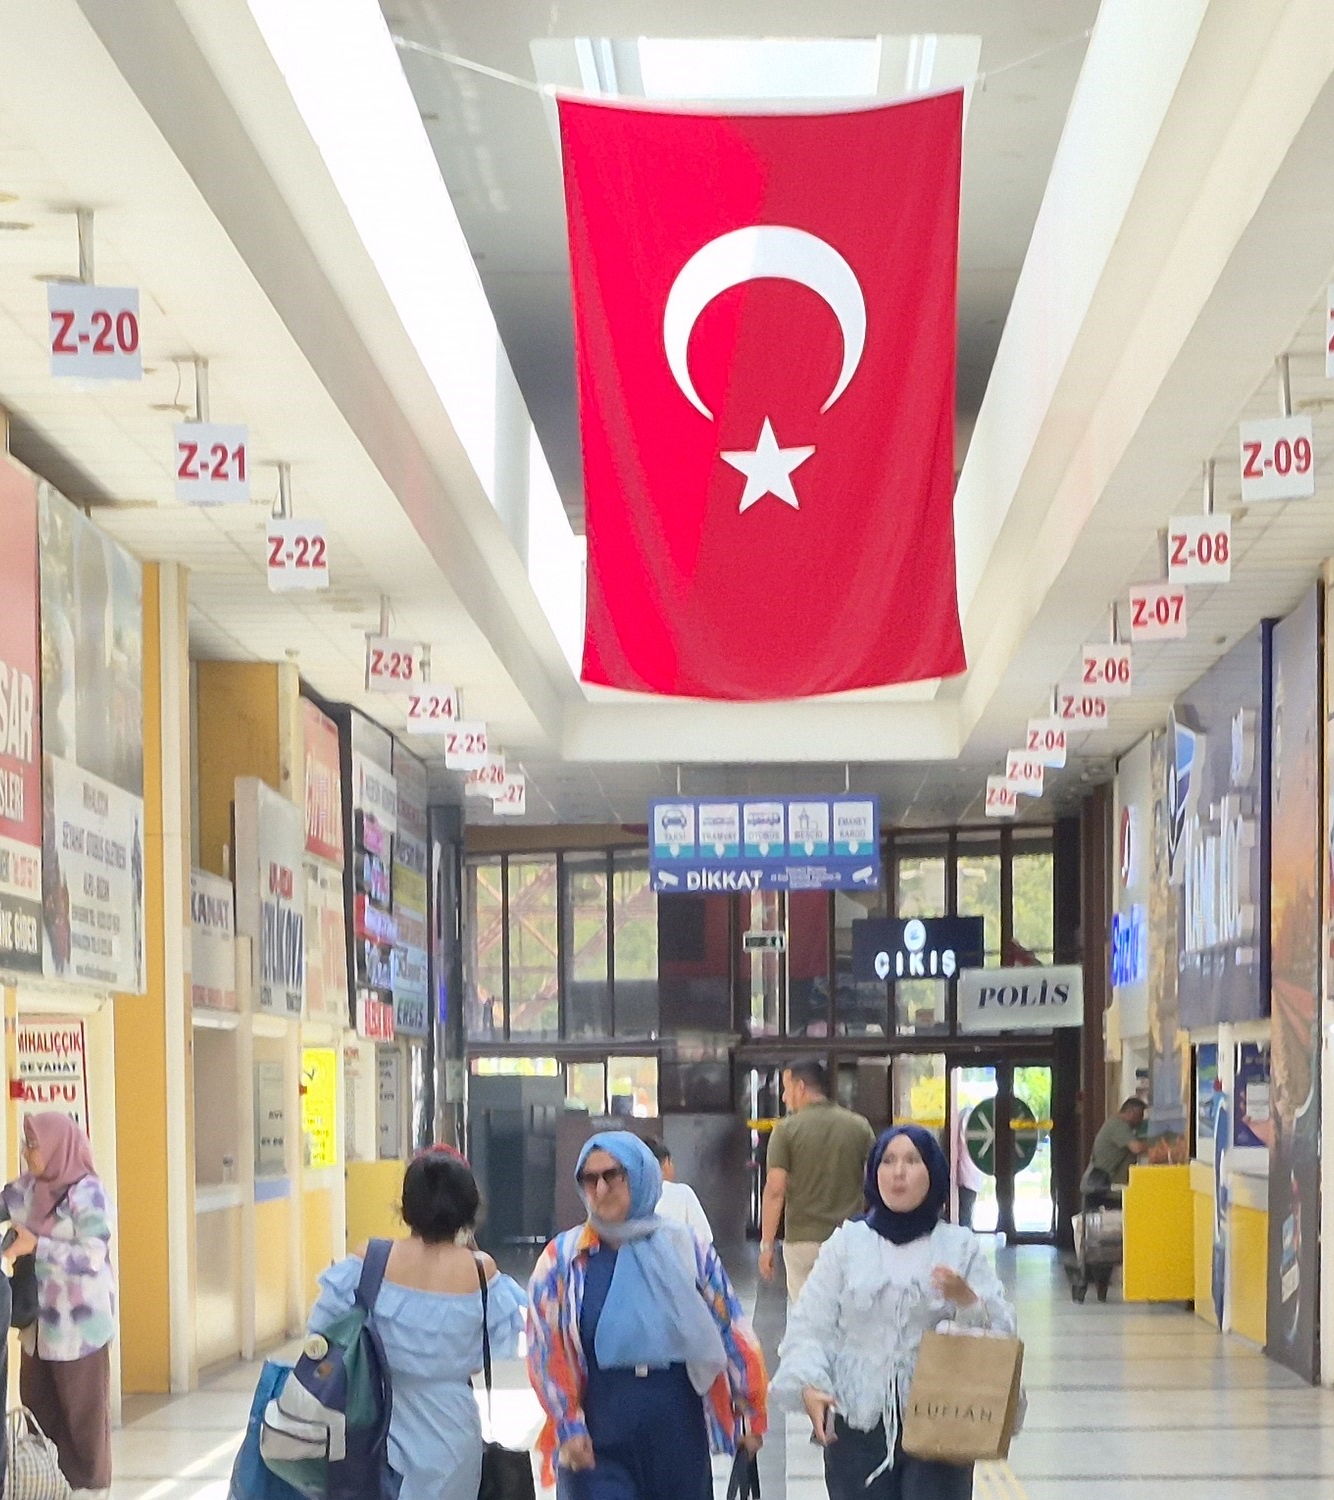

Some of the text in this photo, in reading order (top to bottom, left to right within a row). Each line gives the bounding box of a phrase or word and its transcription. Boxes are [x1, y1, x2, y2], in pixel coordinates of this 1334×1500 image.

[51, 311, 139, 355] Z-20
[178, 442, 247, 481] Z-21
[1242, 437, 1312, 479] Z-09
[269, 536, 326, 569] Z-22
[1170, 533, 1229, 566] Z-08
[1131, 595, 1184, 628] Z-07
[371, 650, 413, 680] Z-23
[1083, 657, 1130, 684] Z-06
[408, 696, 453, 718] Z-24
[1062, 696, 1106, 718] Z-05
[447, 734, 486, 754] Z-25
[1028, 730, 1066, 751] Z-04
[1008, 762, 1041, 780] Z-03
[495, 785, 524, 803] -27
[687, 867, 763, 891] DİKKAT
[874, 949, 957, 981] ÇIKIŞ
[978, 978, 1070, 1009] POLİS
[18, 1027, 82, 1057] MİHALIÇÇIK
[20, 1061, 78, 1073] SEYAHAT
[24, 1084, 77, 1103] ALPU
